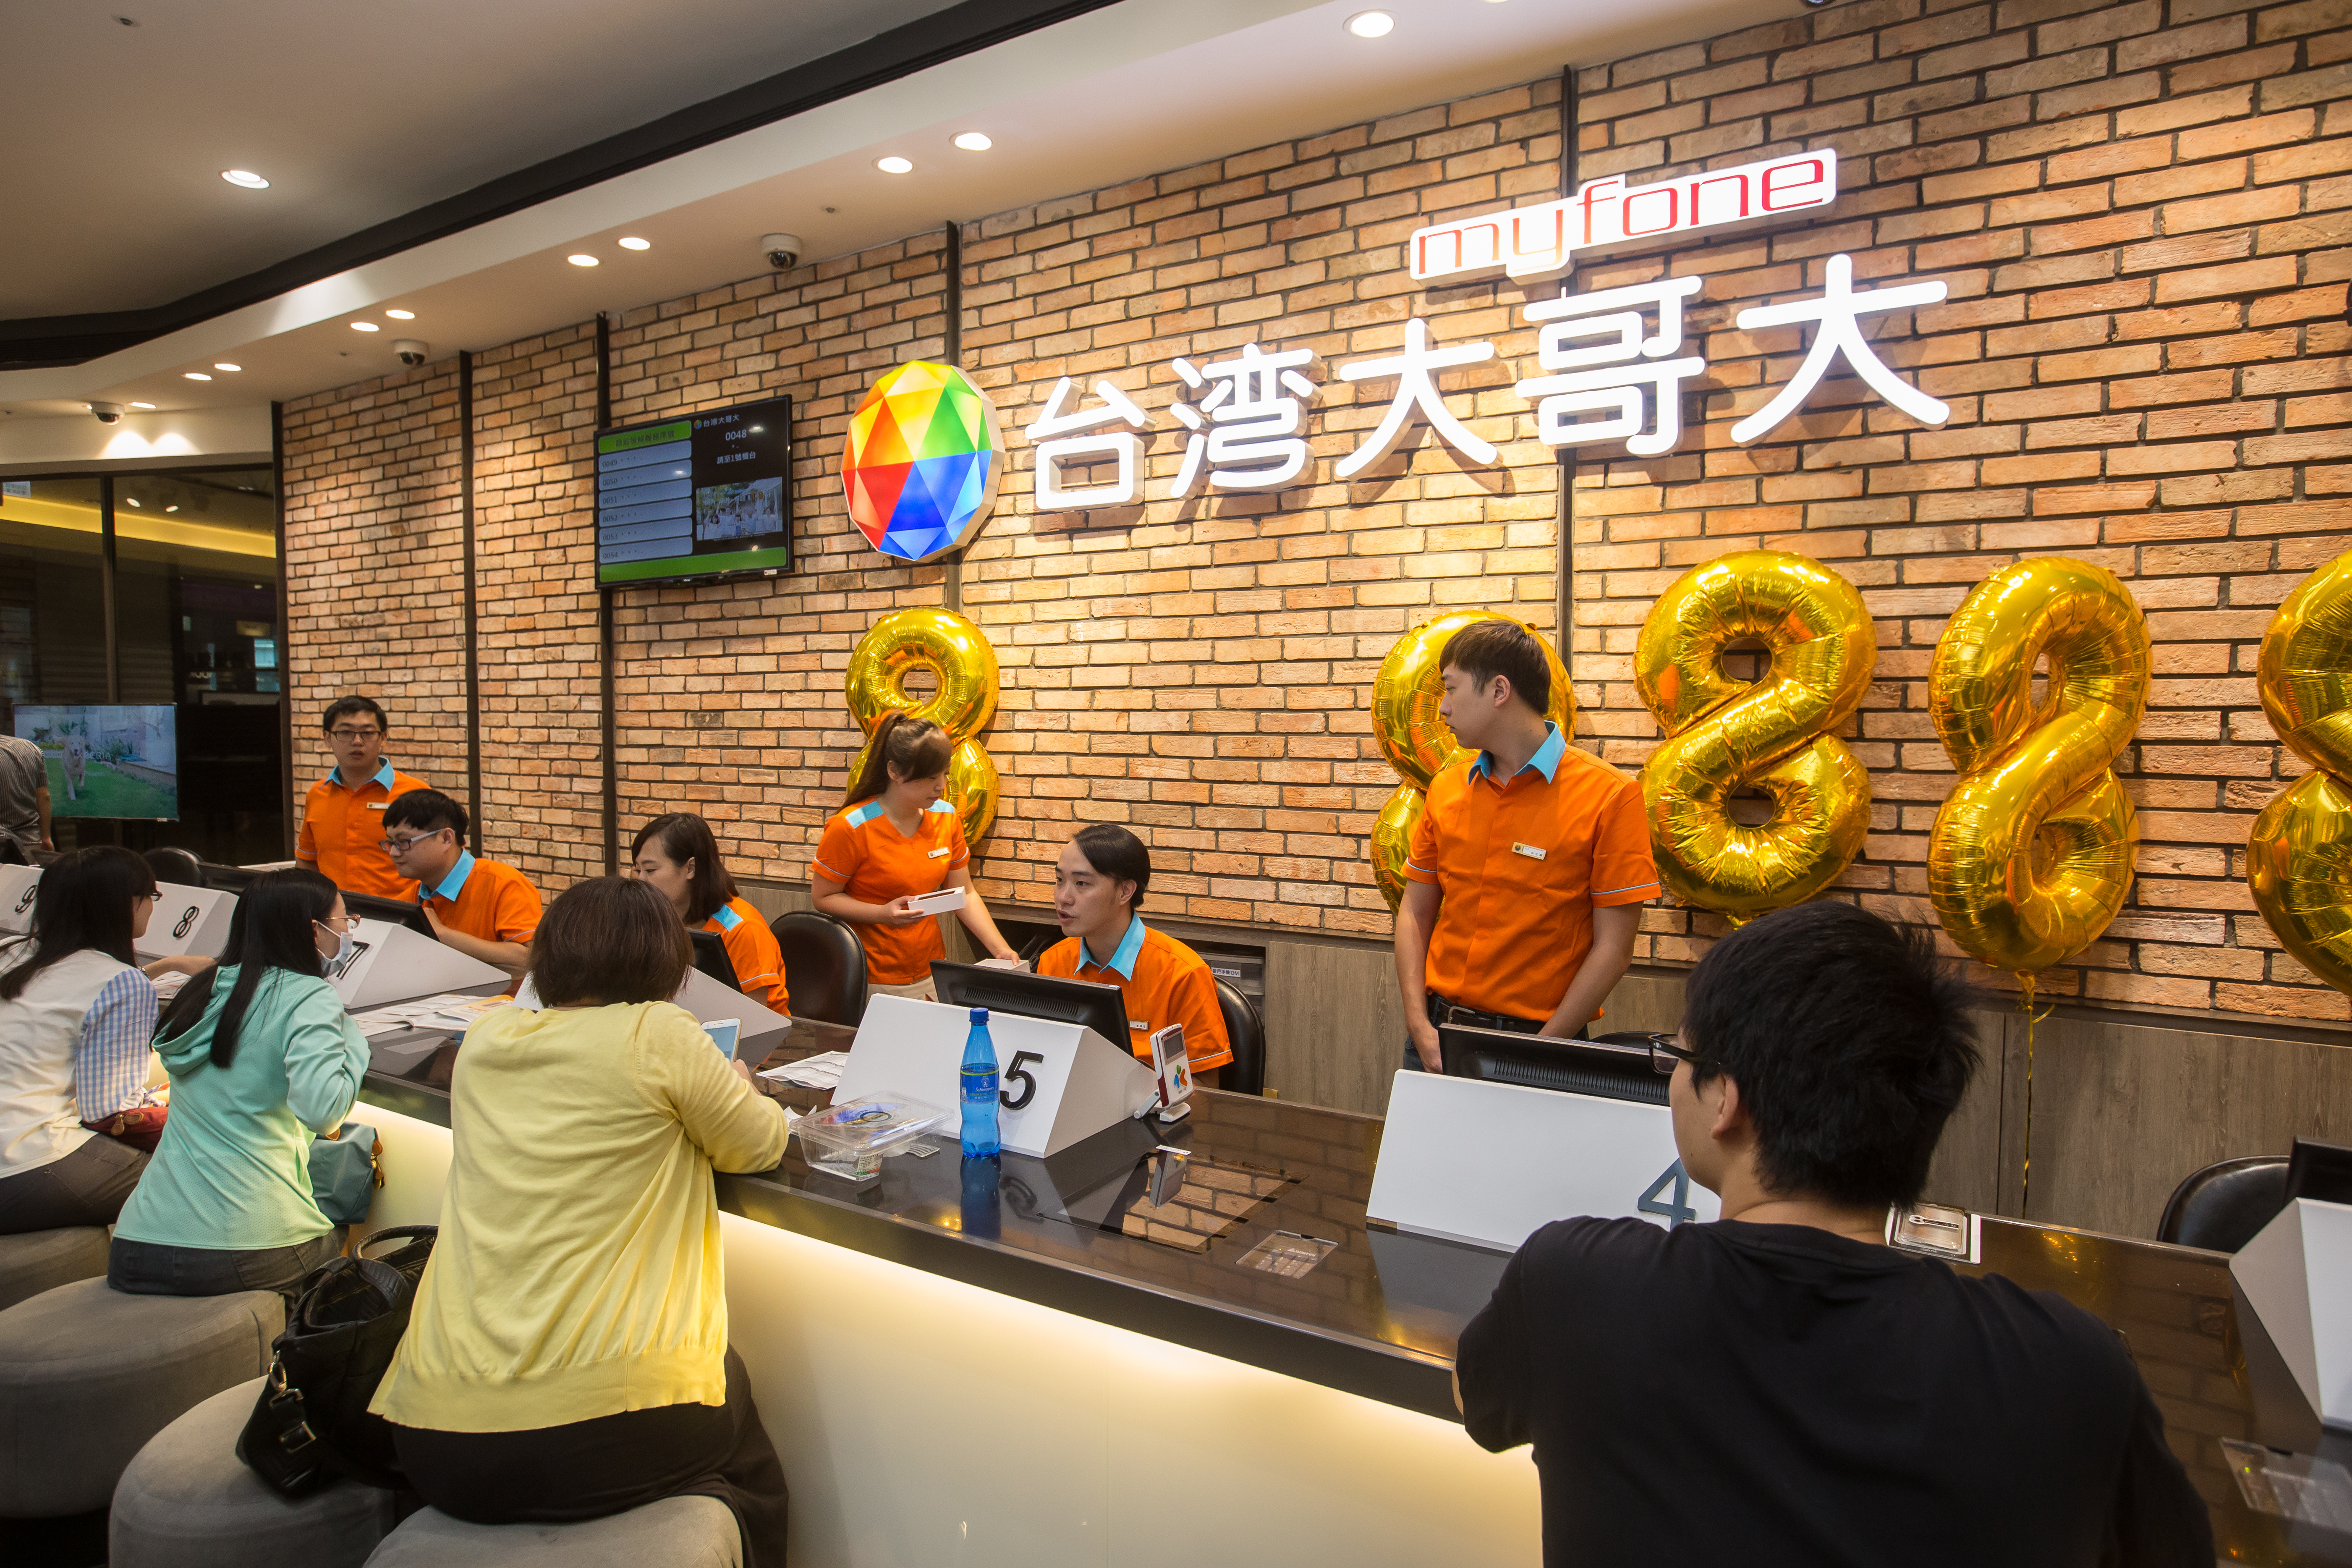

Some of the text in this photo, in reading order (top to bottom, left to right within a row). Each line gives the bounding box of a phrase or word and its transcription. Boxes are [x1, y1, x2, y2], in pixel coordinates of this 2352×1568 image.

[1418, 159, 1824, 274] myfone
[725, 429, 747, 441] 0048
[1633, 550, 1877, 914] 8
[1927, 556, 2152, 971] 8
[14, 884, 37, 914] 9
[173, 906, 200, 939] 8
[999, 1050, 1044, 1111] 5
[1637, 1157, 1695, 1233] 4
